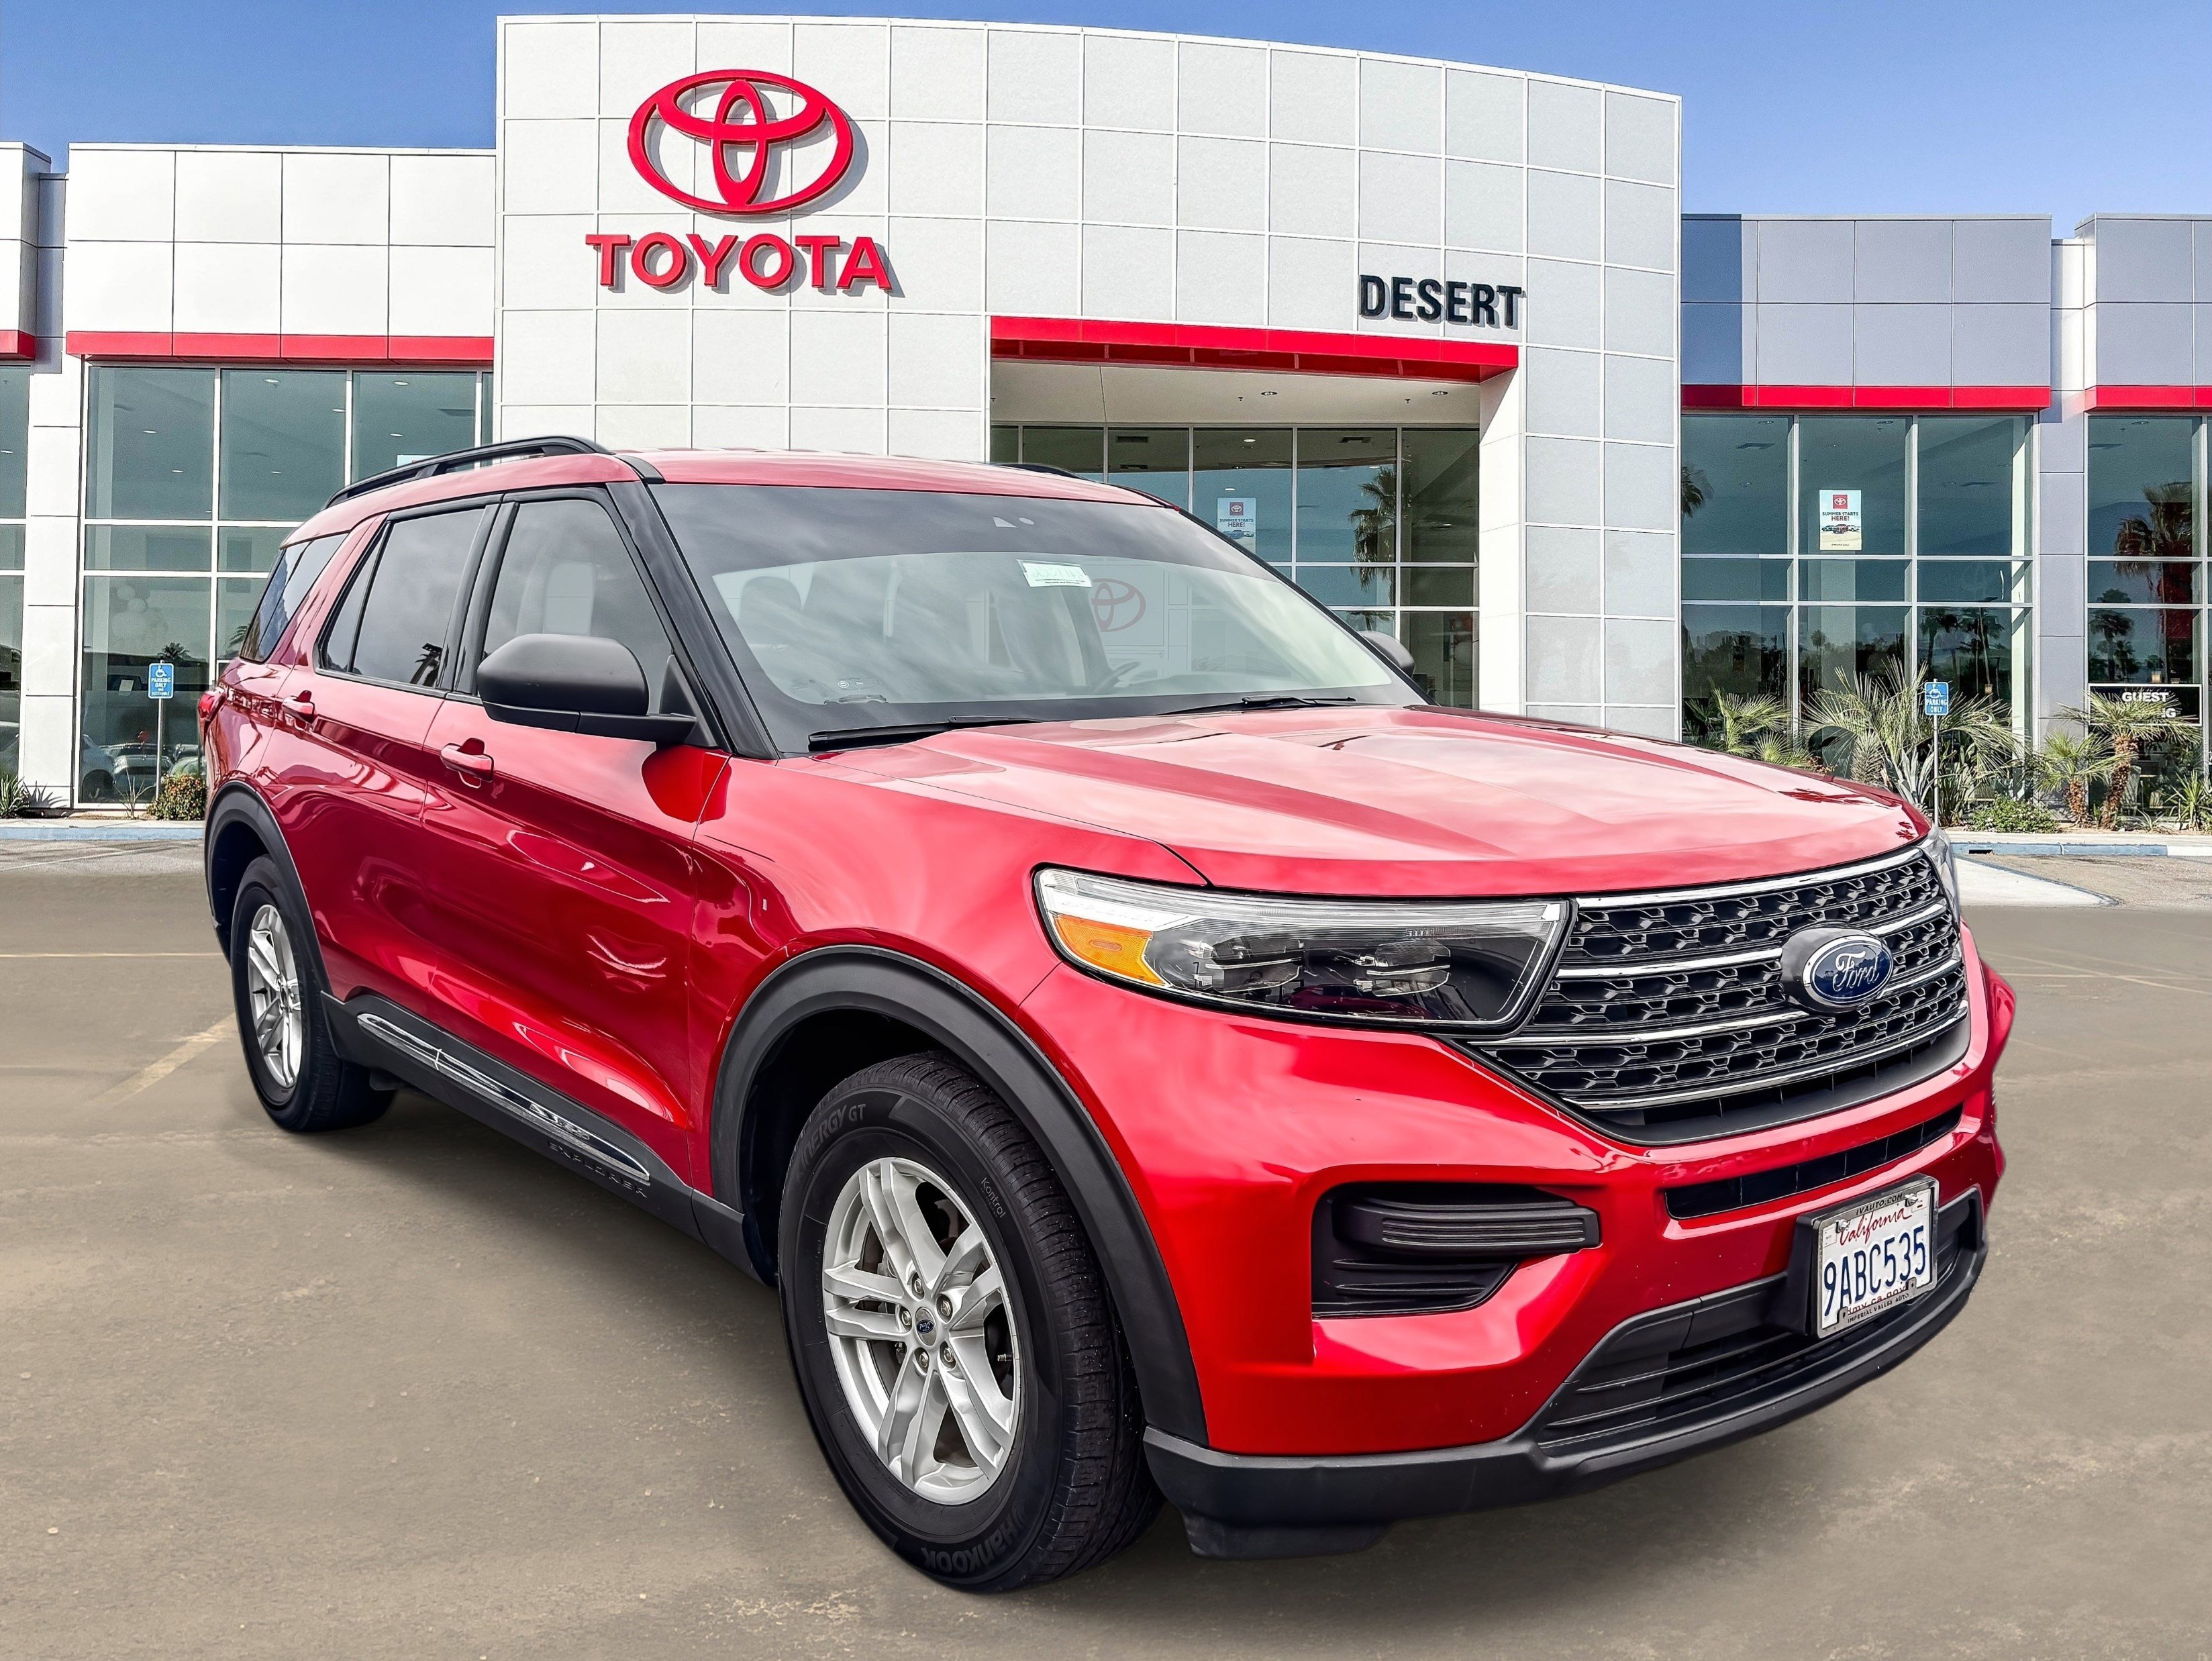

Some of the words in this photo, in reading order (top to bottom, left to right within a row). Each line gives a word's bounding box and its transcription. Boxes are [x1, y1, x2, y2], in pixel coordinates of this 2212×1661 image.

[585, 232, 893, 291] TOYOTA
[1359, 274, 1522, 326] DESERT
[2121, 691, 2169, 703] GUEST
[1832, 950, 1880, 992] Ford
[848, 1103, 866, 1123] GT
[981, 1177, 1006, 1218] Kontrol
[1856, 1193, 1903, 1216] IVAUTO.COM
[1840, 1207, 1913, 1246] California
[1823, 1225, 1925, 1317] 9ABC535
